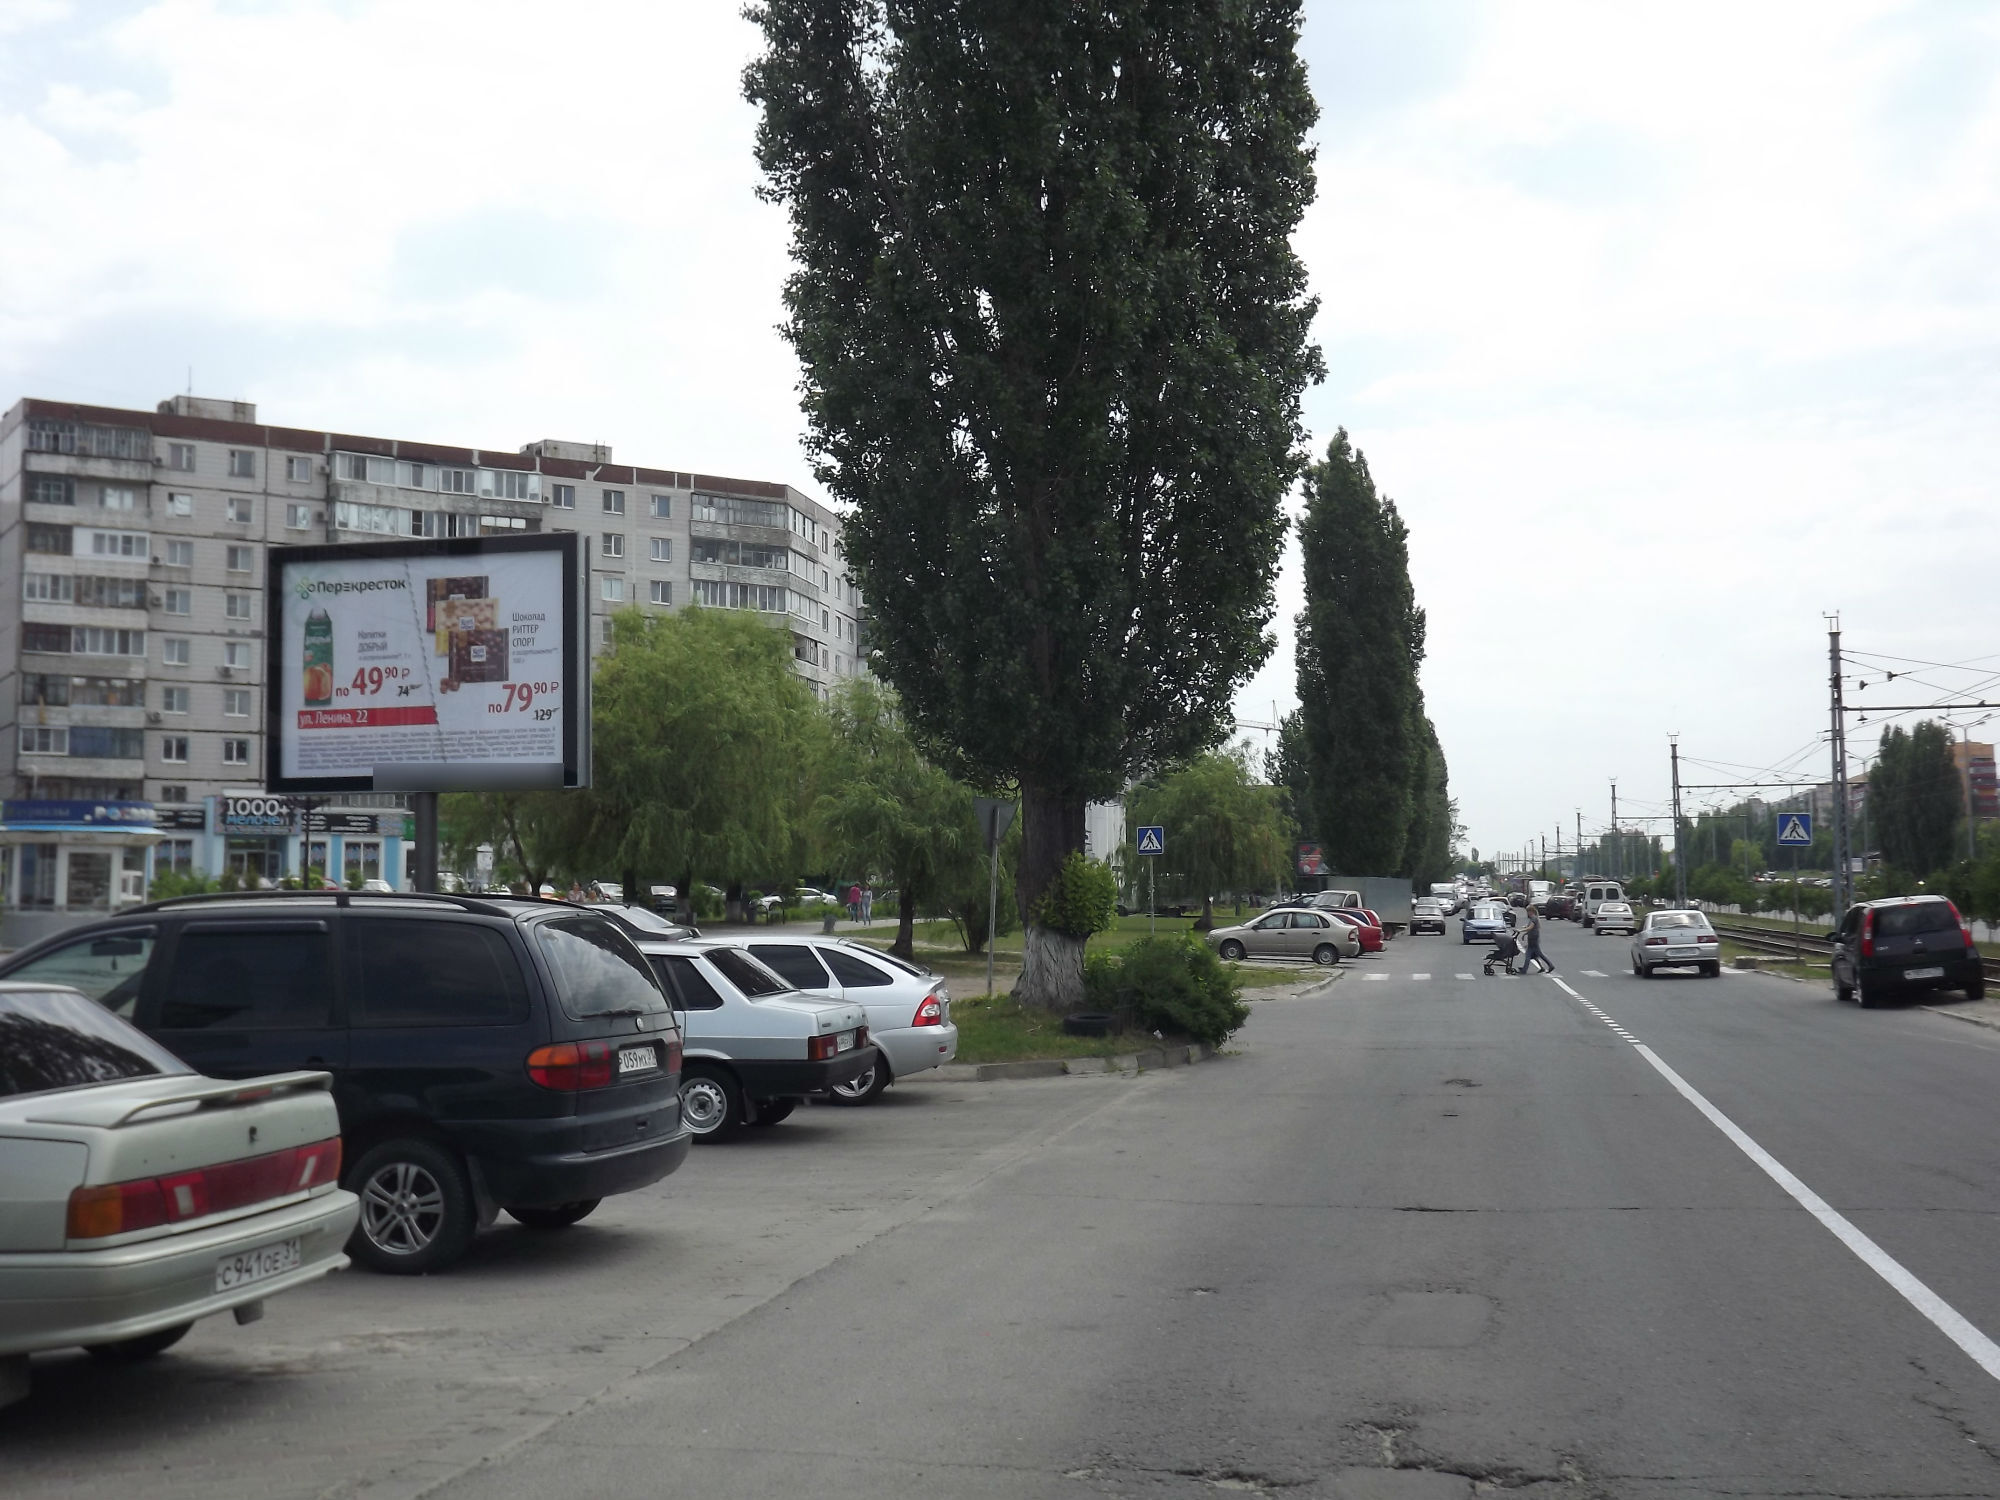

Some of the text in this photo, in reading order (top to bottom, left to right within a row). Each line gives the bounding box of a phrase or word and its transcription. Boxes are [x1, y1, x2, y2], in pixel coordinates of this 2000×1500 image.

[317, 579, 406, 595] Перекресток
[512, 613, 546, 622] Шоколад
[512, 624, 540, 634] РИТТЕР
[512, 637, 535, 647] СПОРТ
[335, 687, 350, 697] по
[488, 703, 503, 713] по
[356, 709, 369, 723] 22
